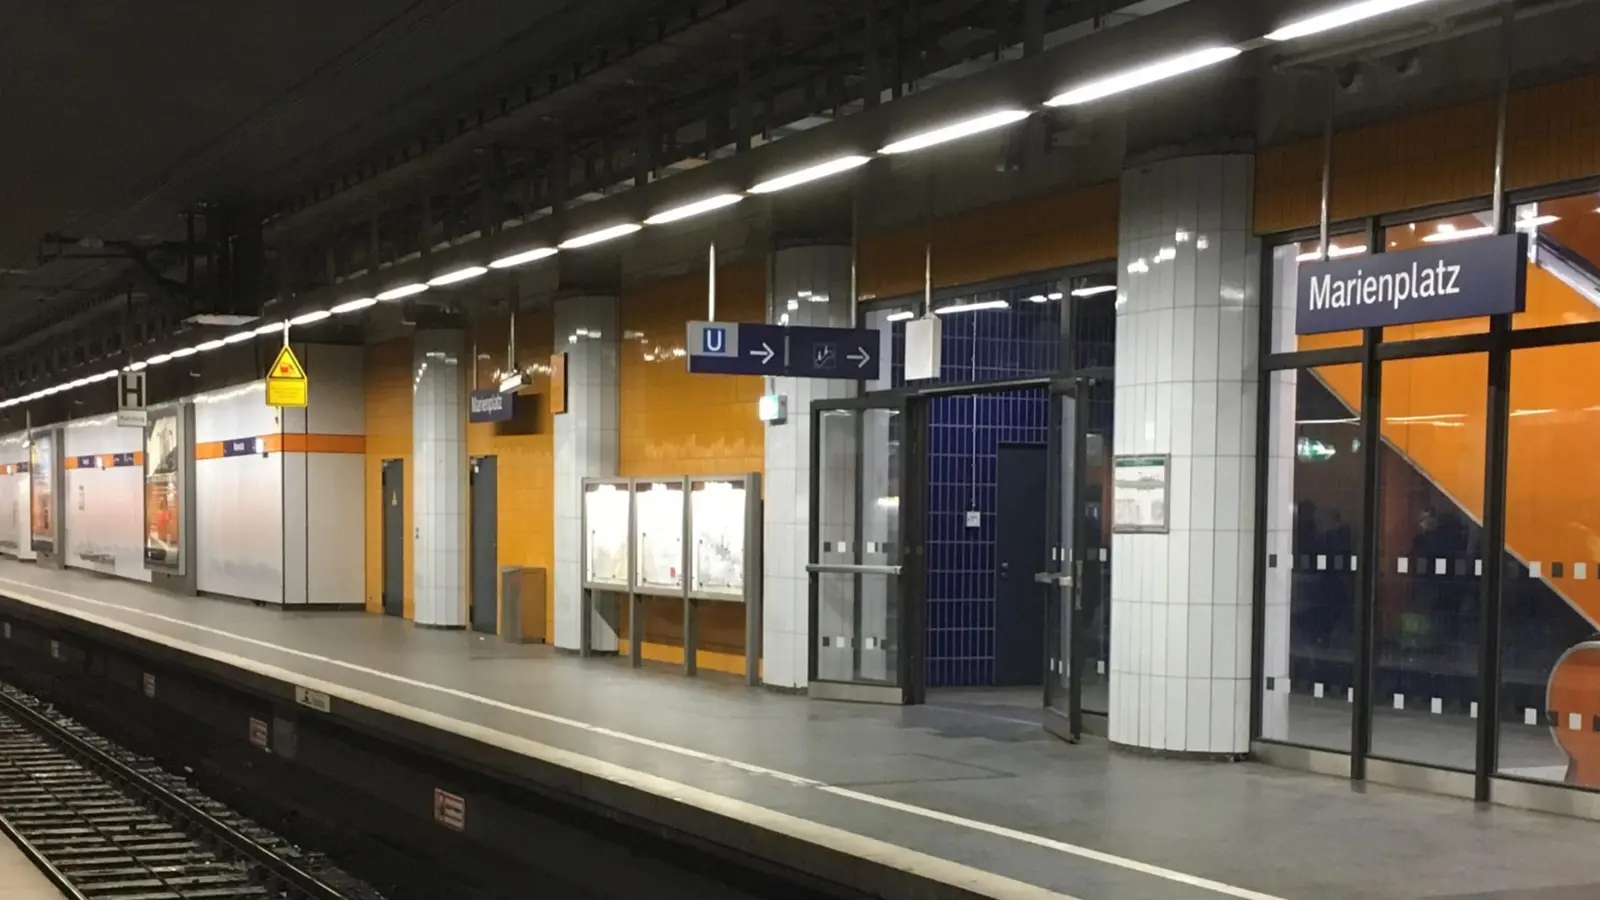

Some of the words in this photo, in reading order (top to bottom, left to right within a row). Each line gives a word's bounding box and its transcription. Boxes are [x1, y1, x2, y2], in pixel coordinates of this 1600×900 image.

[1309, 259, 1461, 311] Marienplatz
[707, 329, 722, 352] U
[121, 374, 143, 407] H
